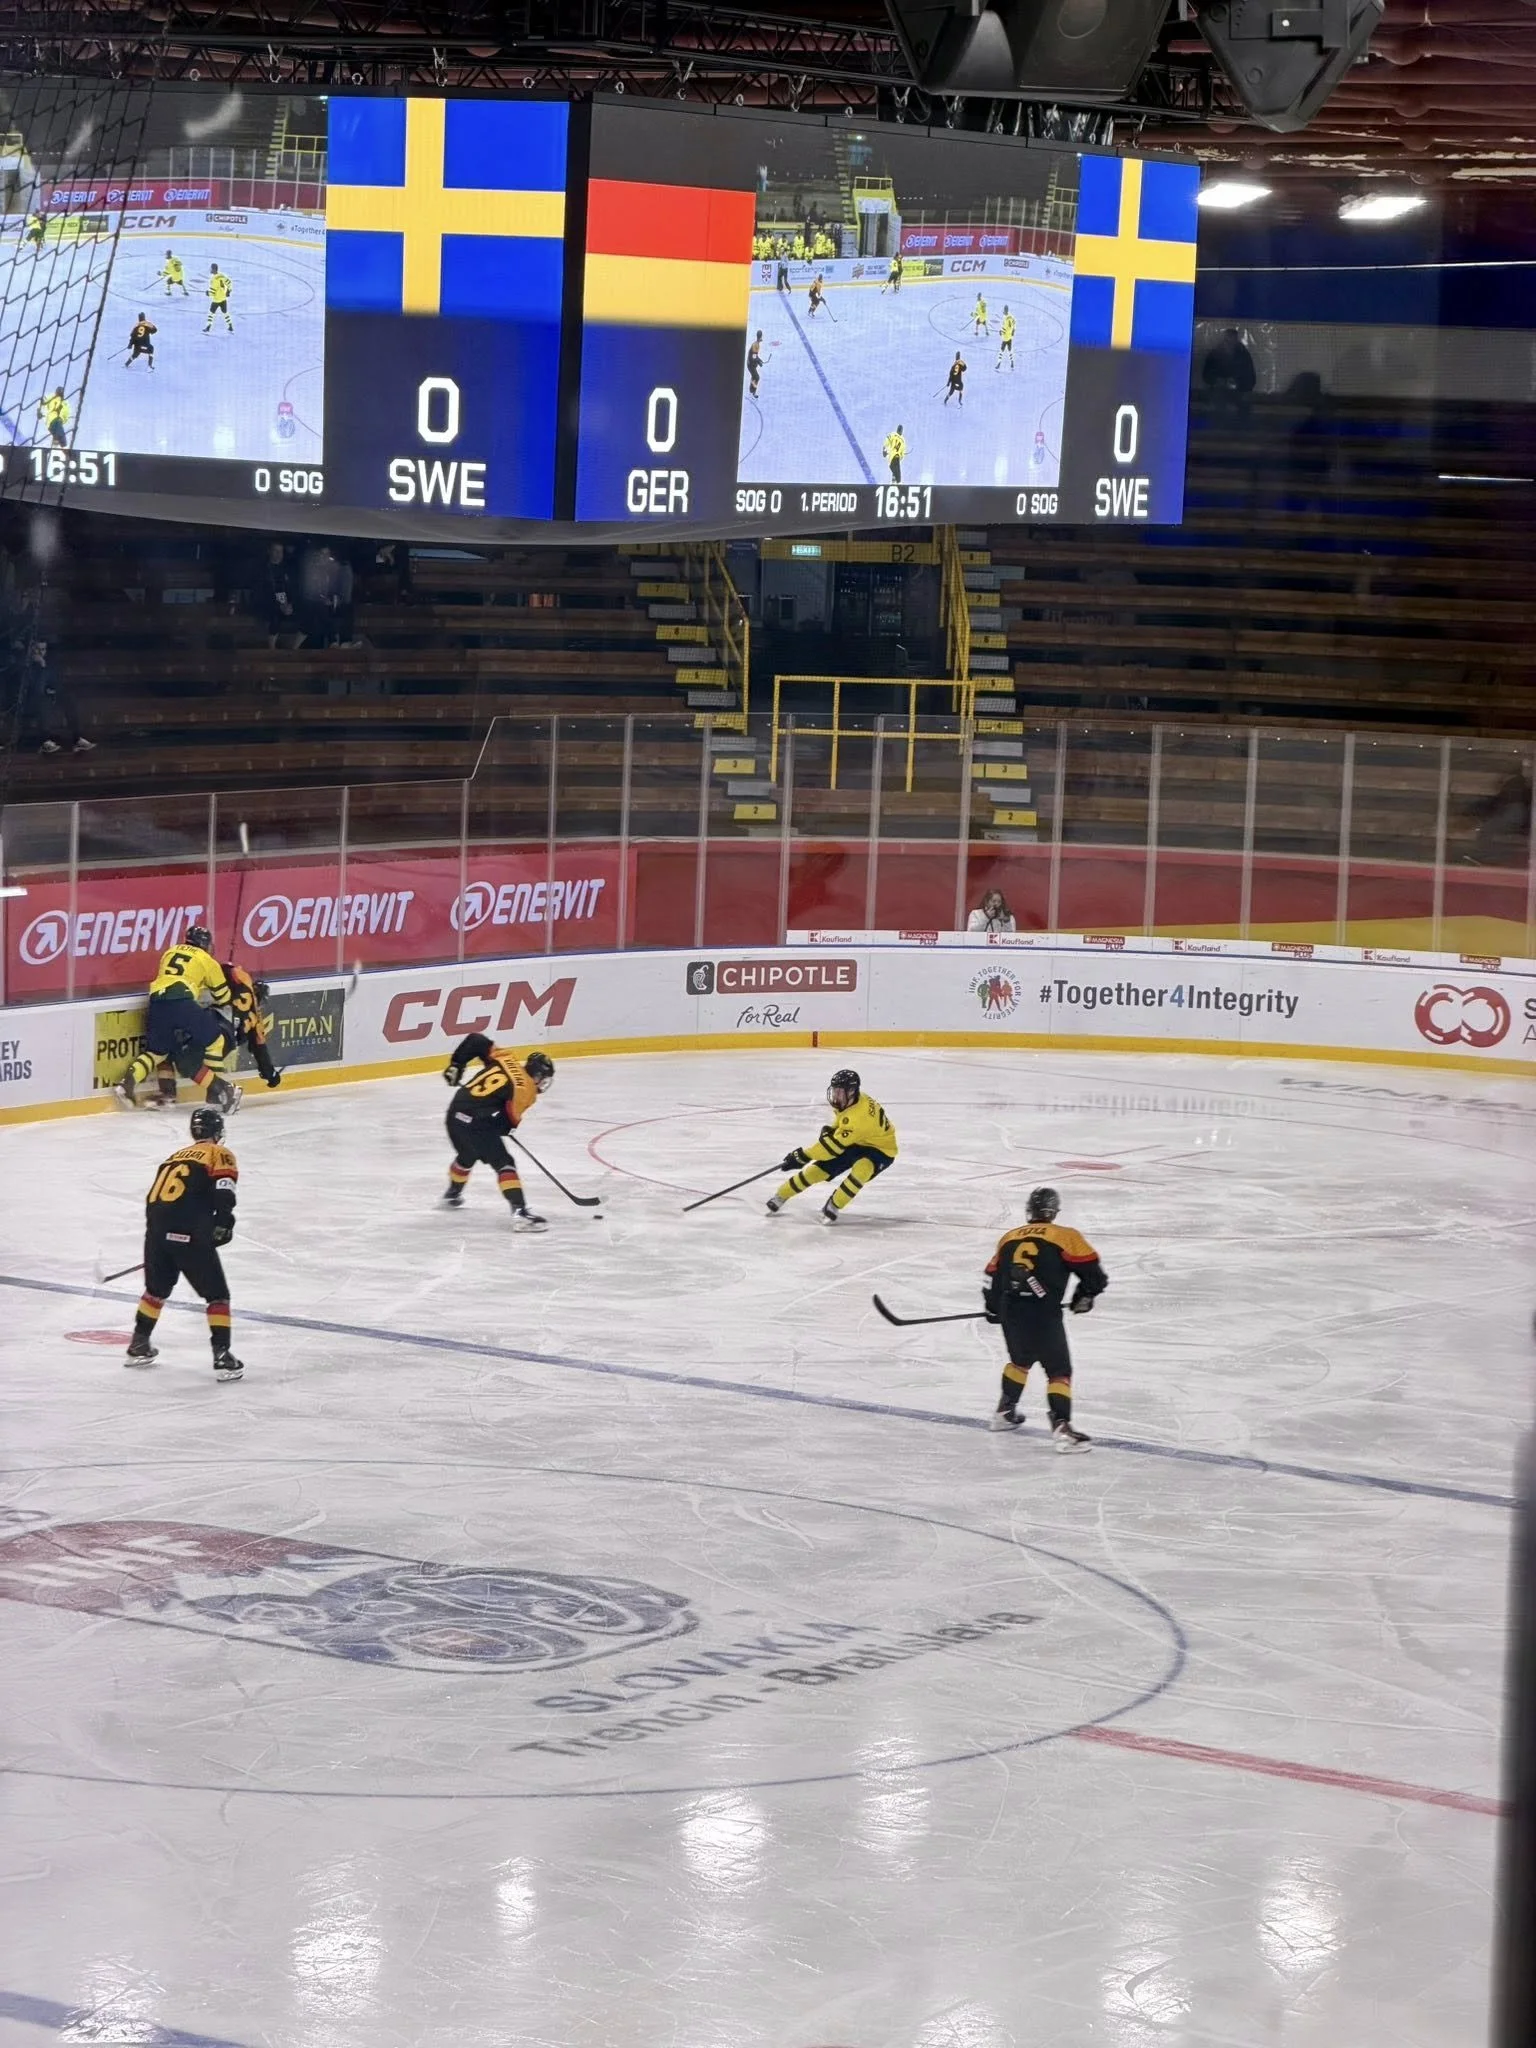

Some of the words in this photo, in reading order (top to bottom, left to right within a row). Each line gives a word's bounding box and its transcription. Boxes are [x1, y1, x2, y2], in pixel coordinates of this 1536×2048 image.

[121, 215, 177, 228] CCM
[950, 259, 986, 273] CCM
[418, 377, 459, 442] 0
[647, 387, 678, 452] 0
[1113, 405, 1138, 462] 0
[30, 448, 117, 486] 16:51
[255, 468, 271, 492] 0
[279, 470, 324, 494] SOG
[389, 458, 486, 506] SWE
[627, 469, 689, 512] GER
[736, 490, 765, 512] SOG
[770, 490, 781, 513] 0
[812, 492, 857, 512] PERIOD
[875, 486, 932, 518] 16:51
[1016, 494, 1026, 515] 0
[1031, 494, 1058, 514] SOG
[1095, 478, 1149, 516] SWE
[892, 544, 915, 562] B2
[492, 878, 605, 925] ENERVIT
[289, 890, 415, 940] ENERVIT
[72, 905, 203, 957] ENERVIT
[821, 936, 853, 944] Kaufland
[1001, 938, 1034, 946] Kaufland
[1090, 936, 1125, 945] MAGNESIA
[1105, 943, 1124, 951] PLUS
[1187, 944, 1221, 953] Kaufland
[1294, 951, 1313, 959] PLUS
[1376, 953, 1411, 963] Kaufland
[165, 952, 192, 976] 5
[722, 965, 850, 987] CHIPOTLE
[382, 977, 578, 1043] CCM
[1040, 979, 1299, 1019] #Together4Integrity
[278, 1014, 333, 1040] TITAN
[737, 1006, 760, 1028] for
[762, 1004, 801, 1028] Real
[466, 1065, 509, 1097] 19
[148, 1163, 190, 1204] 16
[533, 1620, 881, 1714] SLOVAKIA
